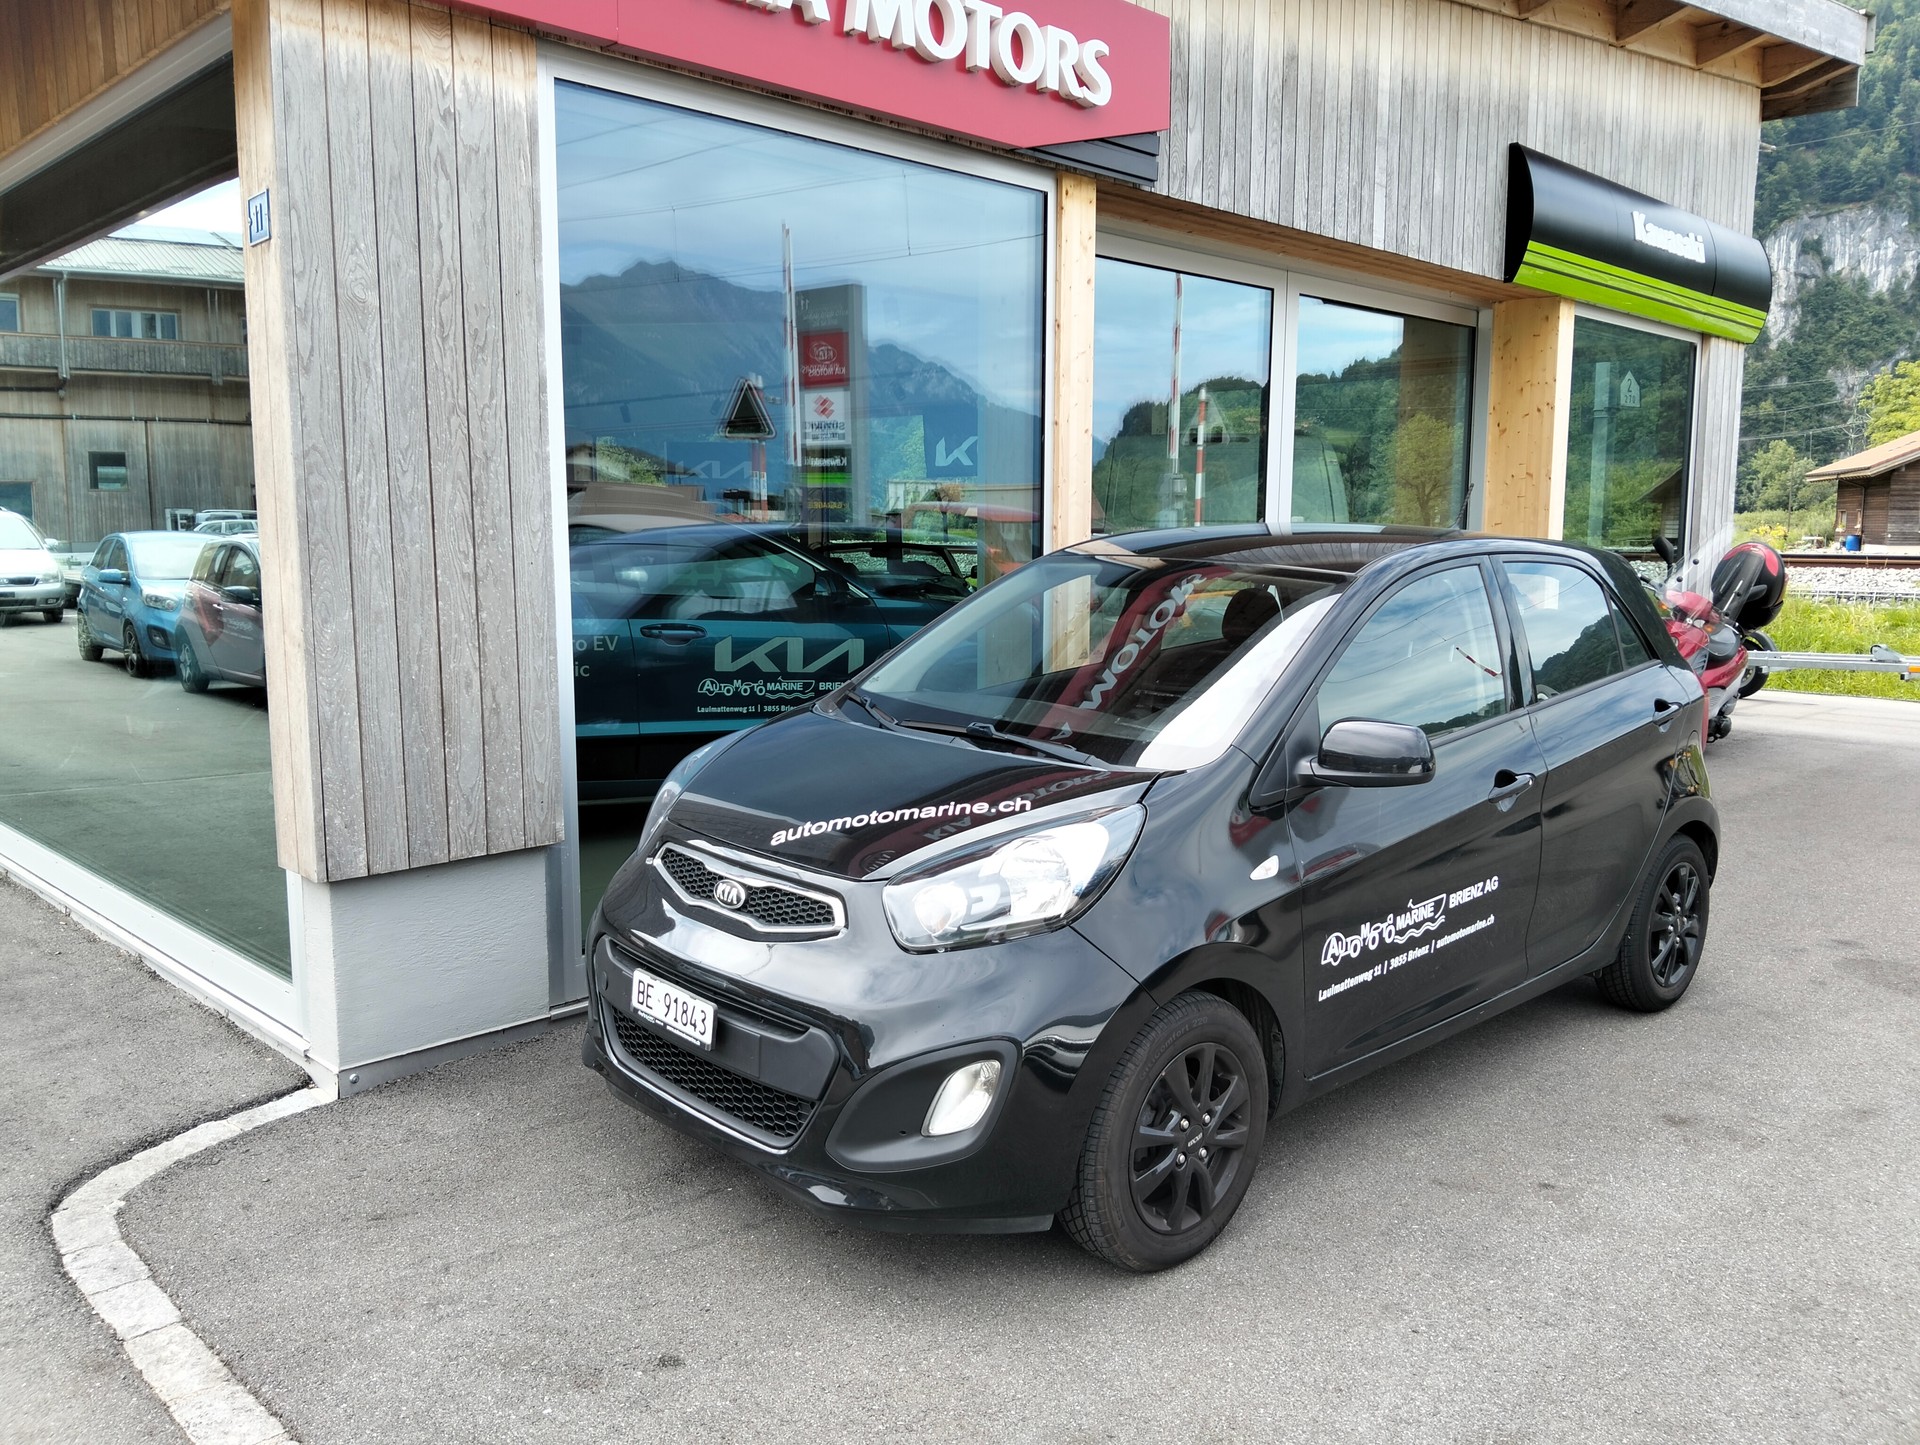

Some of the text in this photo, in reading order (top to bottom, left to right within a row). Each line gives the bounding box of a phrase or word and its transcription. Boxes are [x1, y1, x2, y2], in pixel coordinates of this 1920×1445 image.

[843, 0, 1112, 108] MOTORS
[593, 635, 619, 651] EV
[766, 681, 804, 692] MARINE
[769, 797, 1032, 847] automotomarine.ch
[716, 882, 738, 905] KIA
[1396, 902, 1435, 931] MARINE
[1449, 882, 1485, 909] BRIENZ
[1484, 875, 1499, 894] AG
[1389, 953, 1407, 970] 3855
[1408, 943, 1430, 962] Brienz
[637, 980, 655, 1010] BE
[664, 992, 707, 1036] 91843
